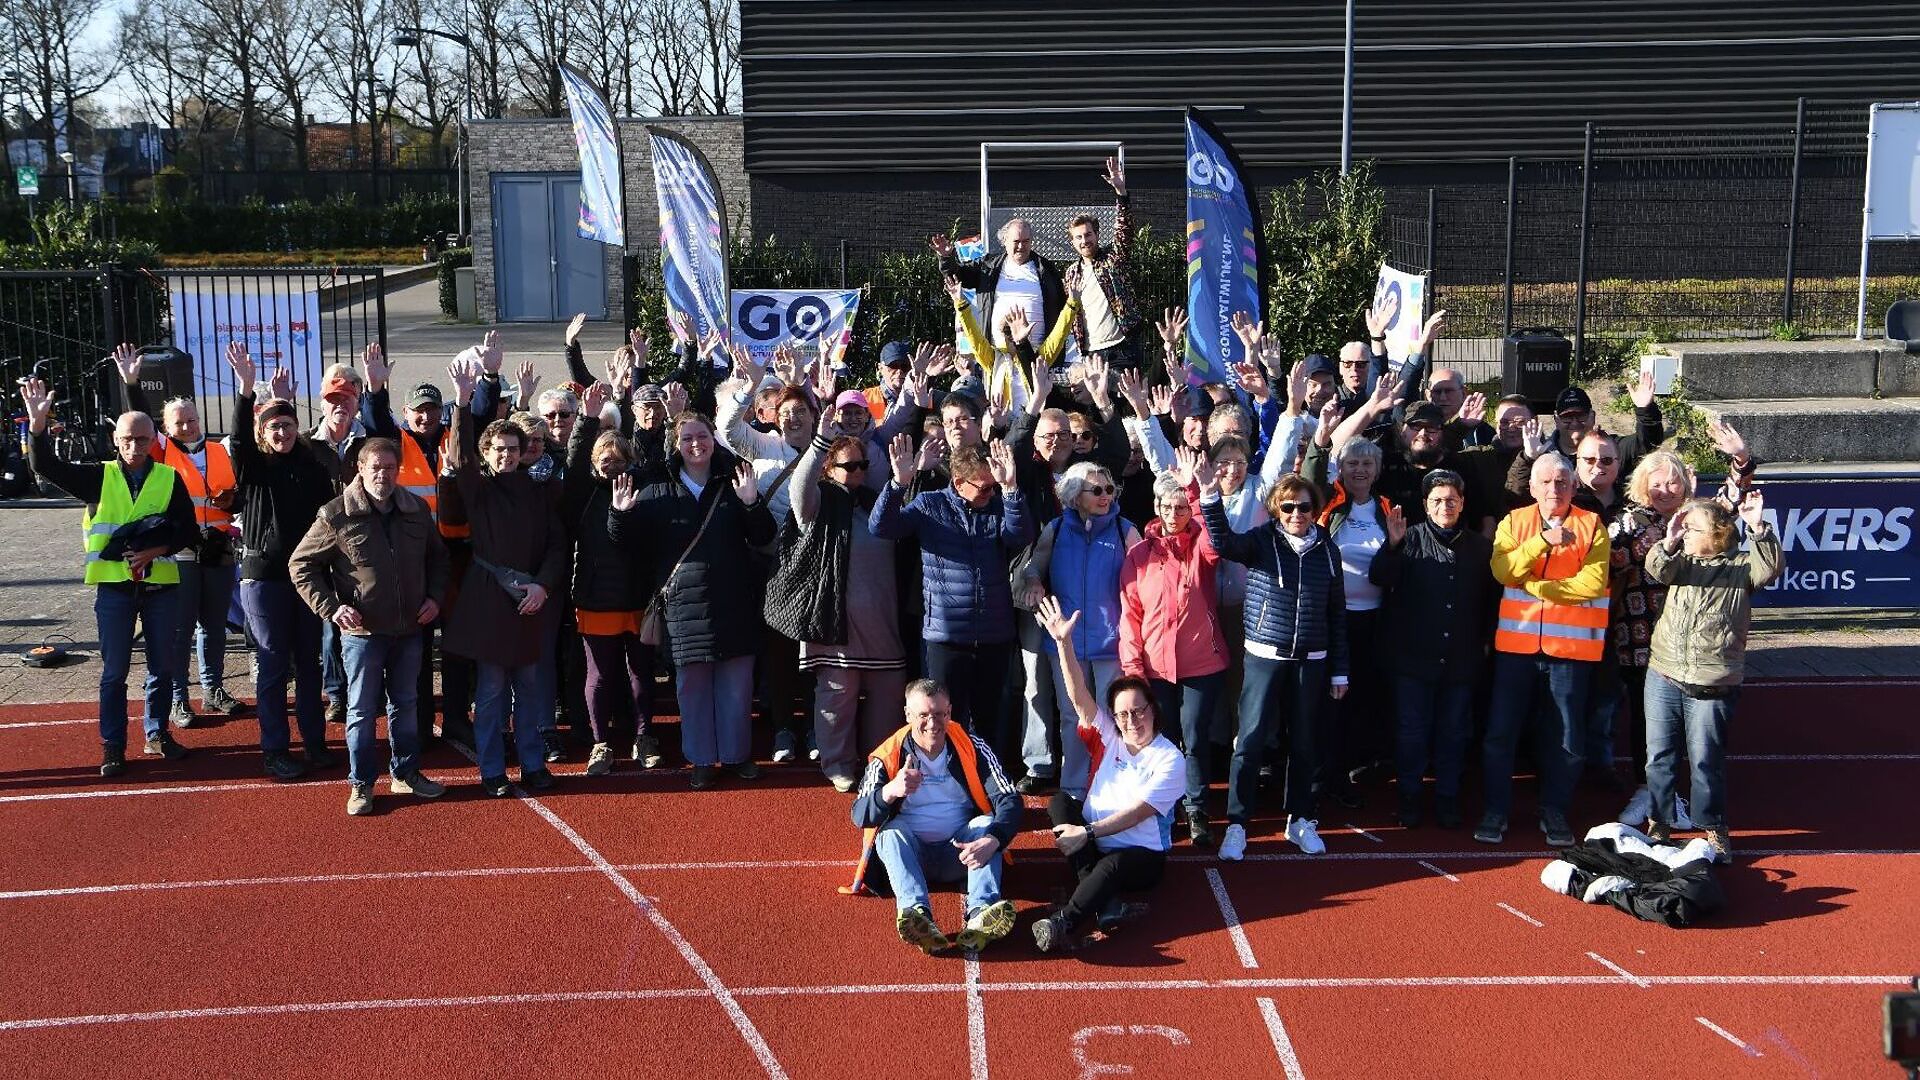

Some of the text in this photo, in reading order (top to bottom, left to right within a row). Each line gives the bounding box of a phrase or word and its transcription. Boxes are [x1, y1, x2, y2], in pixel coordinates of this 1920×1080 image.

[738, 295, 831, 341] GO
[1525, 362, 1562, 372] MIPRO
[140, 381, 164, 391] PRO
[1736, 507, 1915, 552] AKERS
